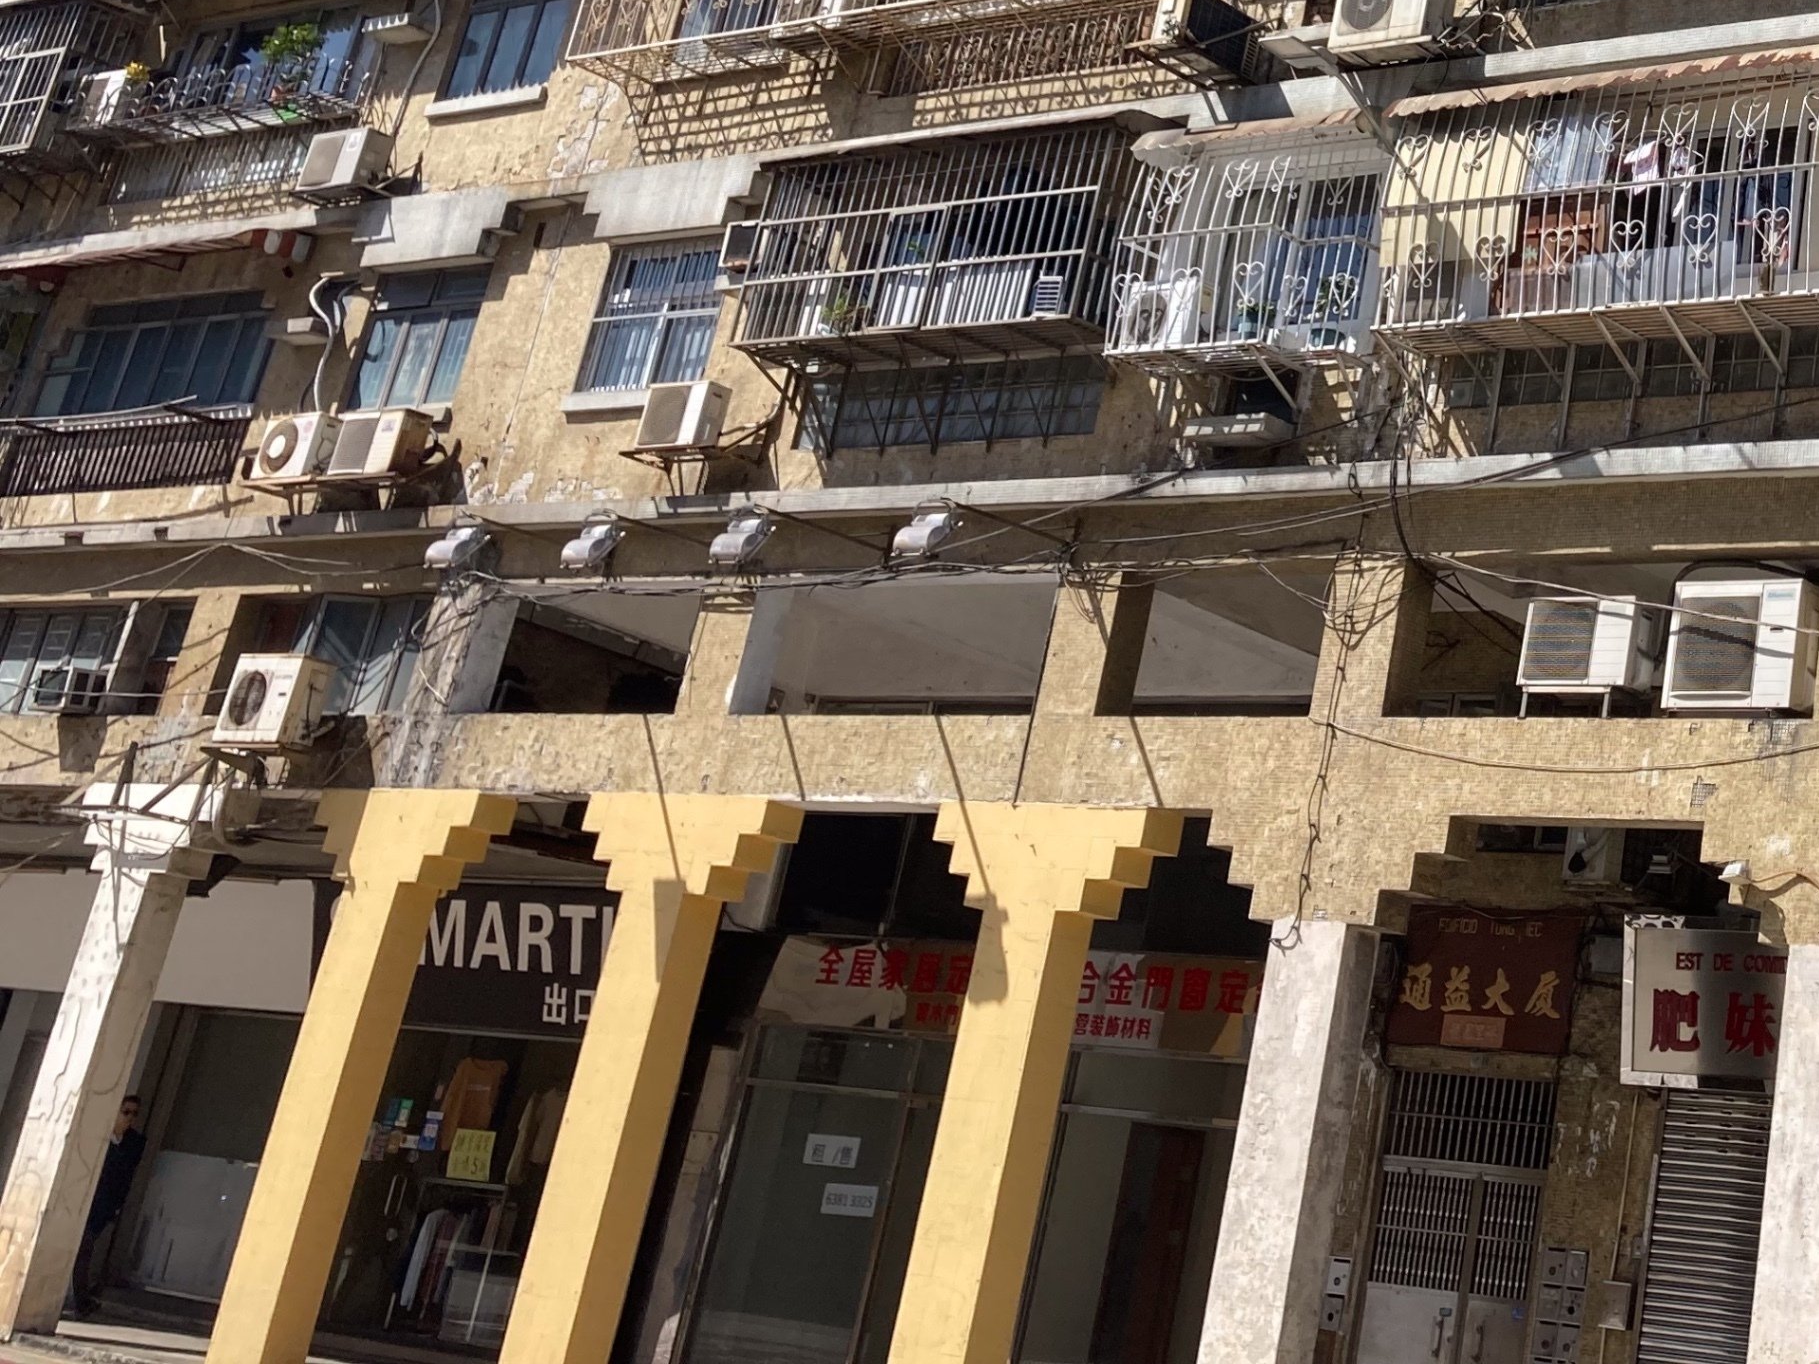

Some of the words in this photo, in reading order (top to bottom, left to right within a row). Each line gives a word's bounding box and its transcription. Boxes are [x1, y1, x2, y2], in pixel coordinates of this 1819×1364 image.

[1675, 952, 1703, 971] EST
[1713, 953, 1733, 972] DE
[1650, 988, 1777, 1058] 肥妹
